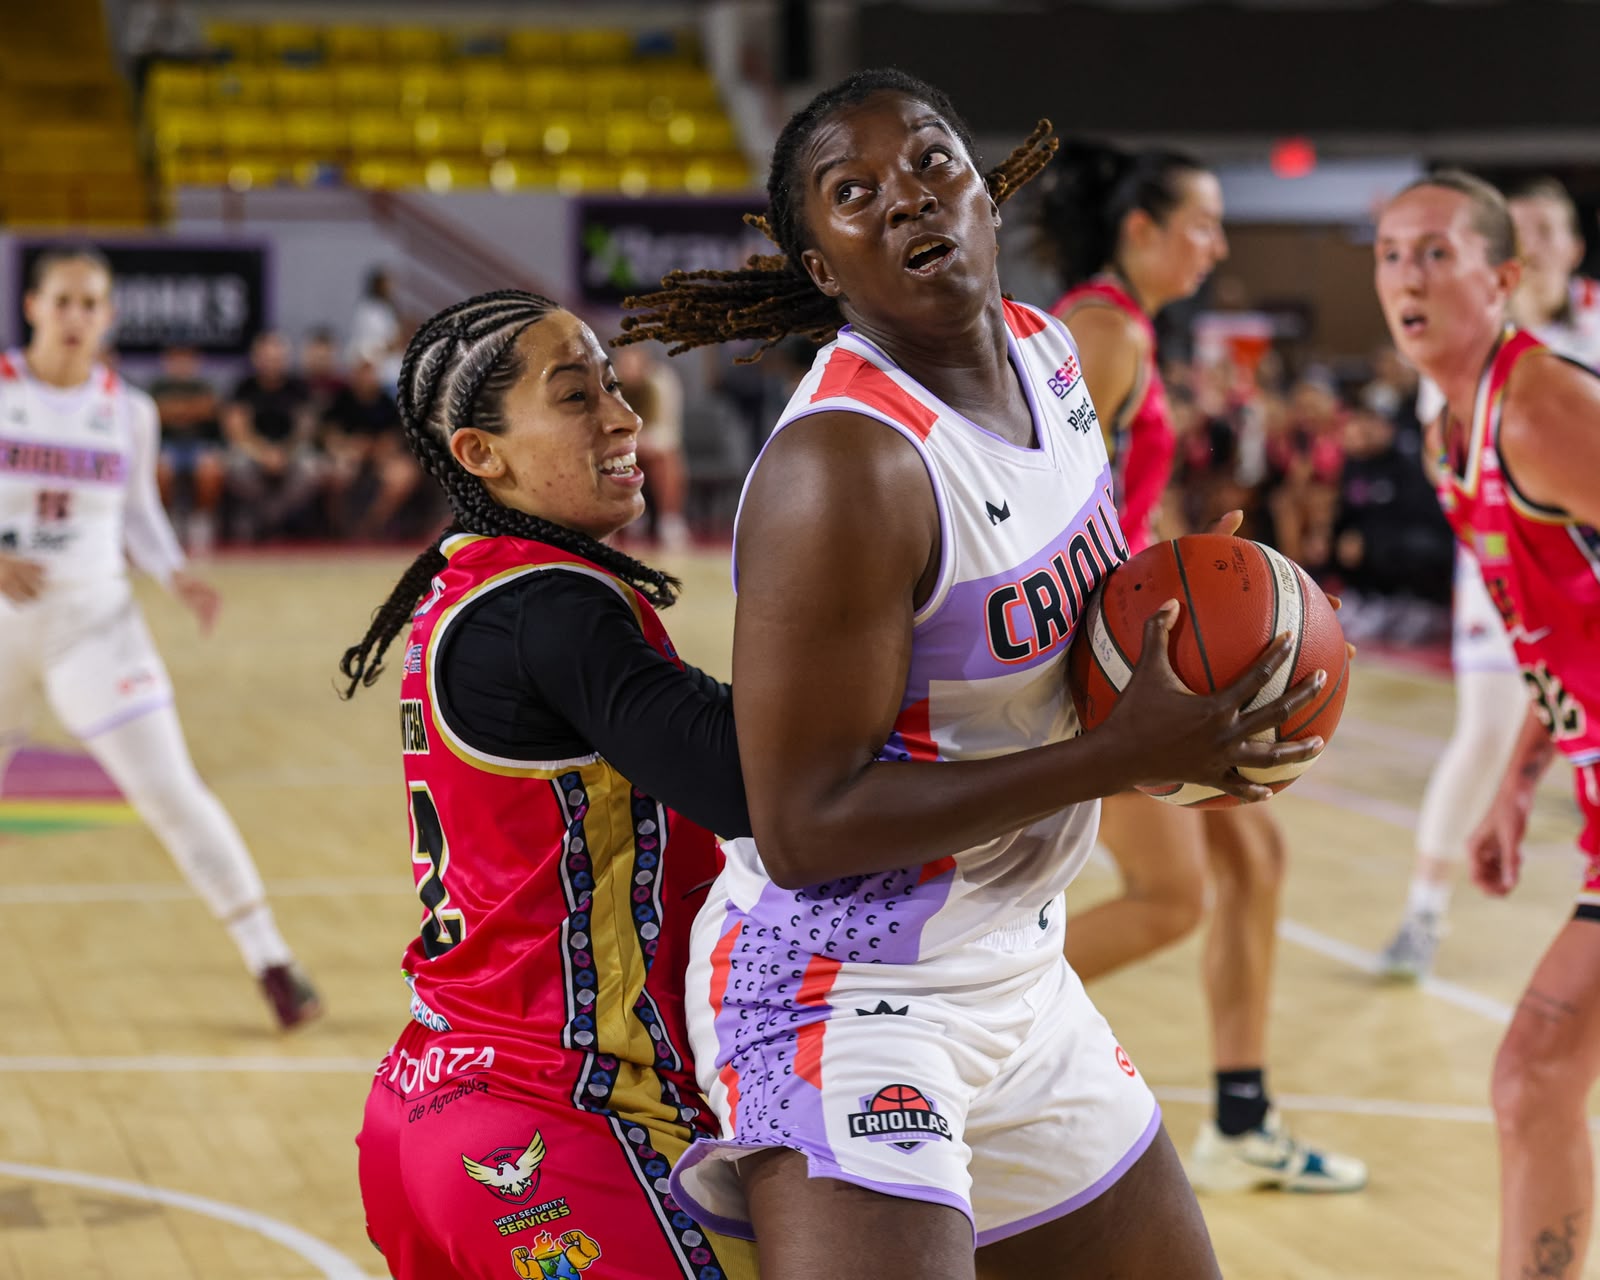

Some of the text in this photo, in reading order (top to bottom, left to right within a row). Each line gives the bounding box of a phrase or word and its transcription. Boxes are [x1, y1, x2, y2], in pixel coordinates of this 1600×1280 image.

[984, 485, 1130, 665] CRIOLL
[408, 1103, 425, 1123] de
[852, 1111, 951, 1136] CRIOLLAS
[494, 1197, 565, 1226] WEST SECURITY
[498, 1205, 571, 1237] SERVICES
